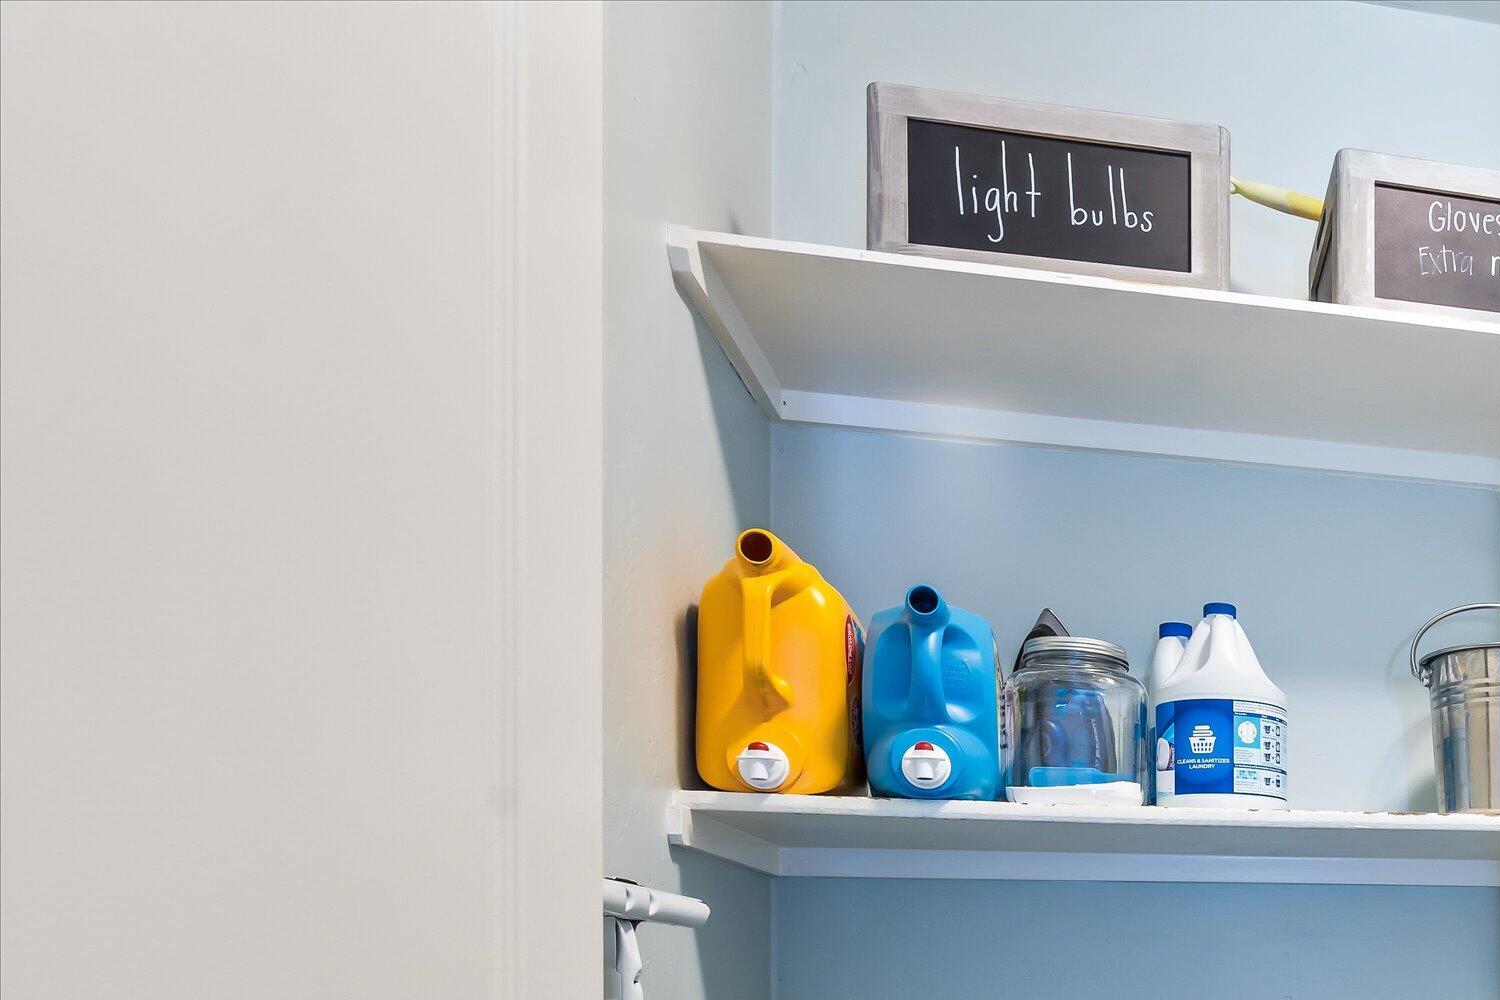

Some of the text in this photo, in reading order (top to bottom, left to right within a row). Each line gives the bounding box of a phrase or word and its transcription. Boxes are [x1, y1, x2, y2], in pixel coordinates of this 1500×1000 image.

[954, 140, 1153, 242] light bulbs
[1418, 244, 1473, 276] Extra
